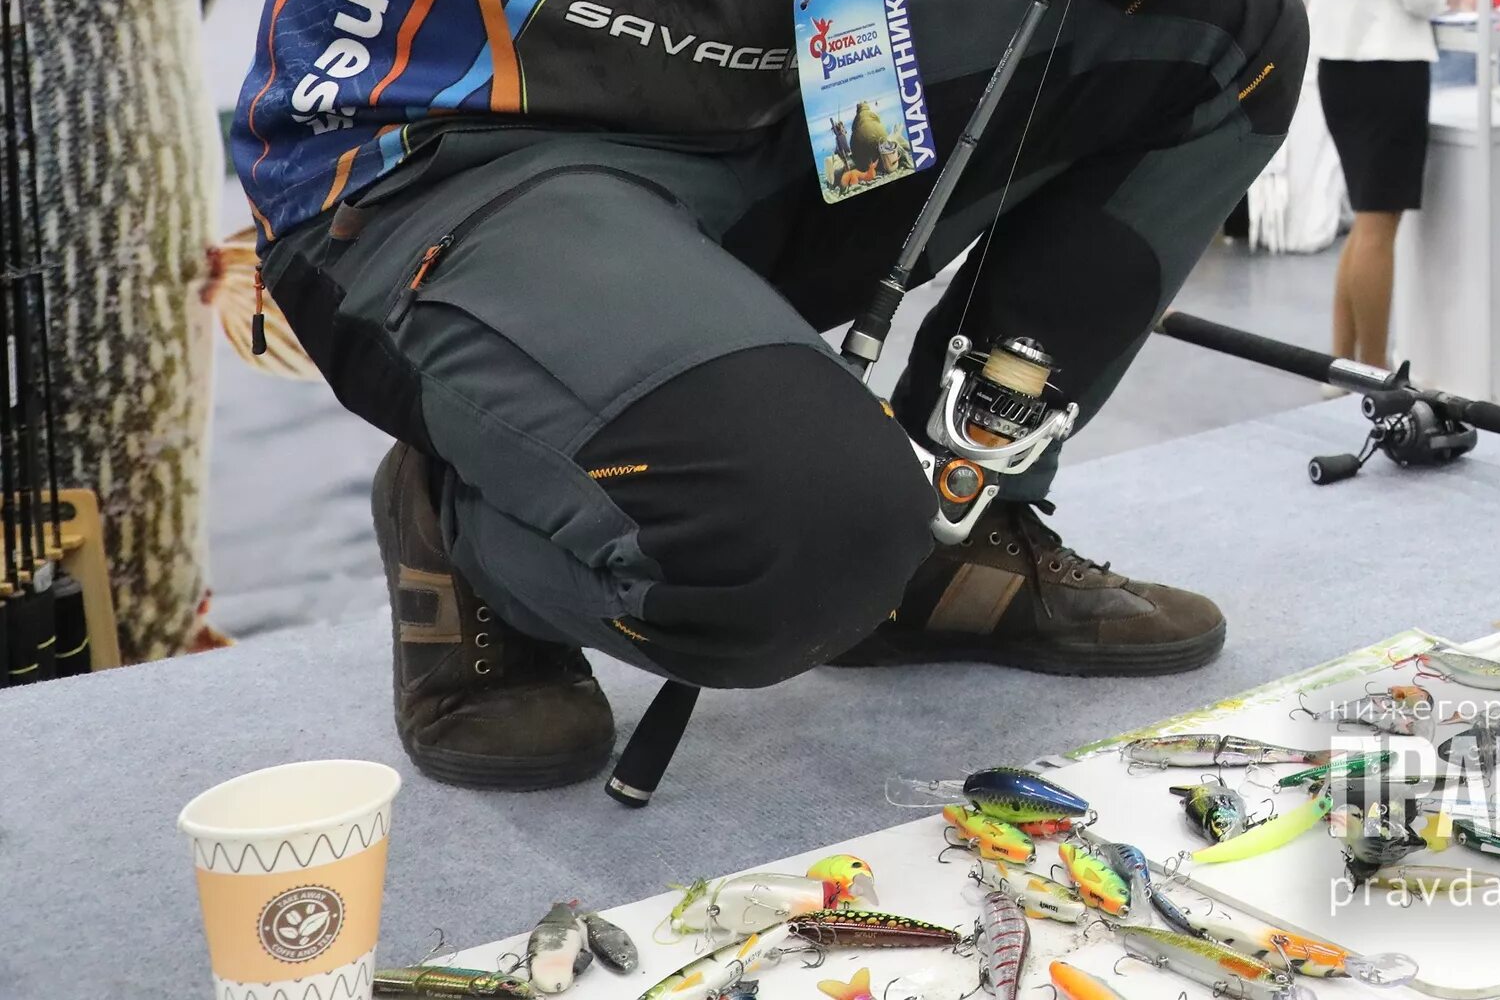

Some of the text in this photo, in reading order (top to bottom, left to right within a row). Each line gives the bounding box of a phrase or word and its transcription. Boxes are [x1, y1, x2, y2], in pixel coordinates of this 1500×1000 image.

[565, 0, 799, 70] SAVAGE
[856, 30, 878, 45] 2020
[301, 891, 327, 901] AWAY
[297, 945, 318, 958] AND
